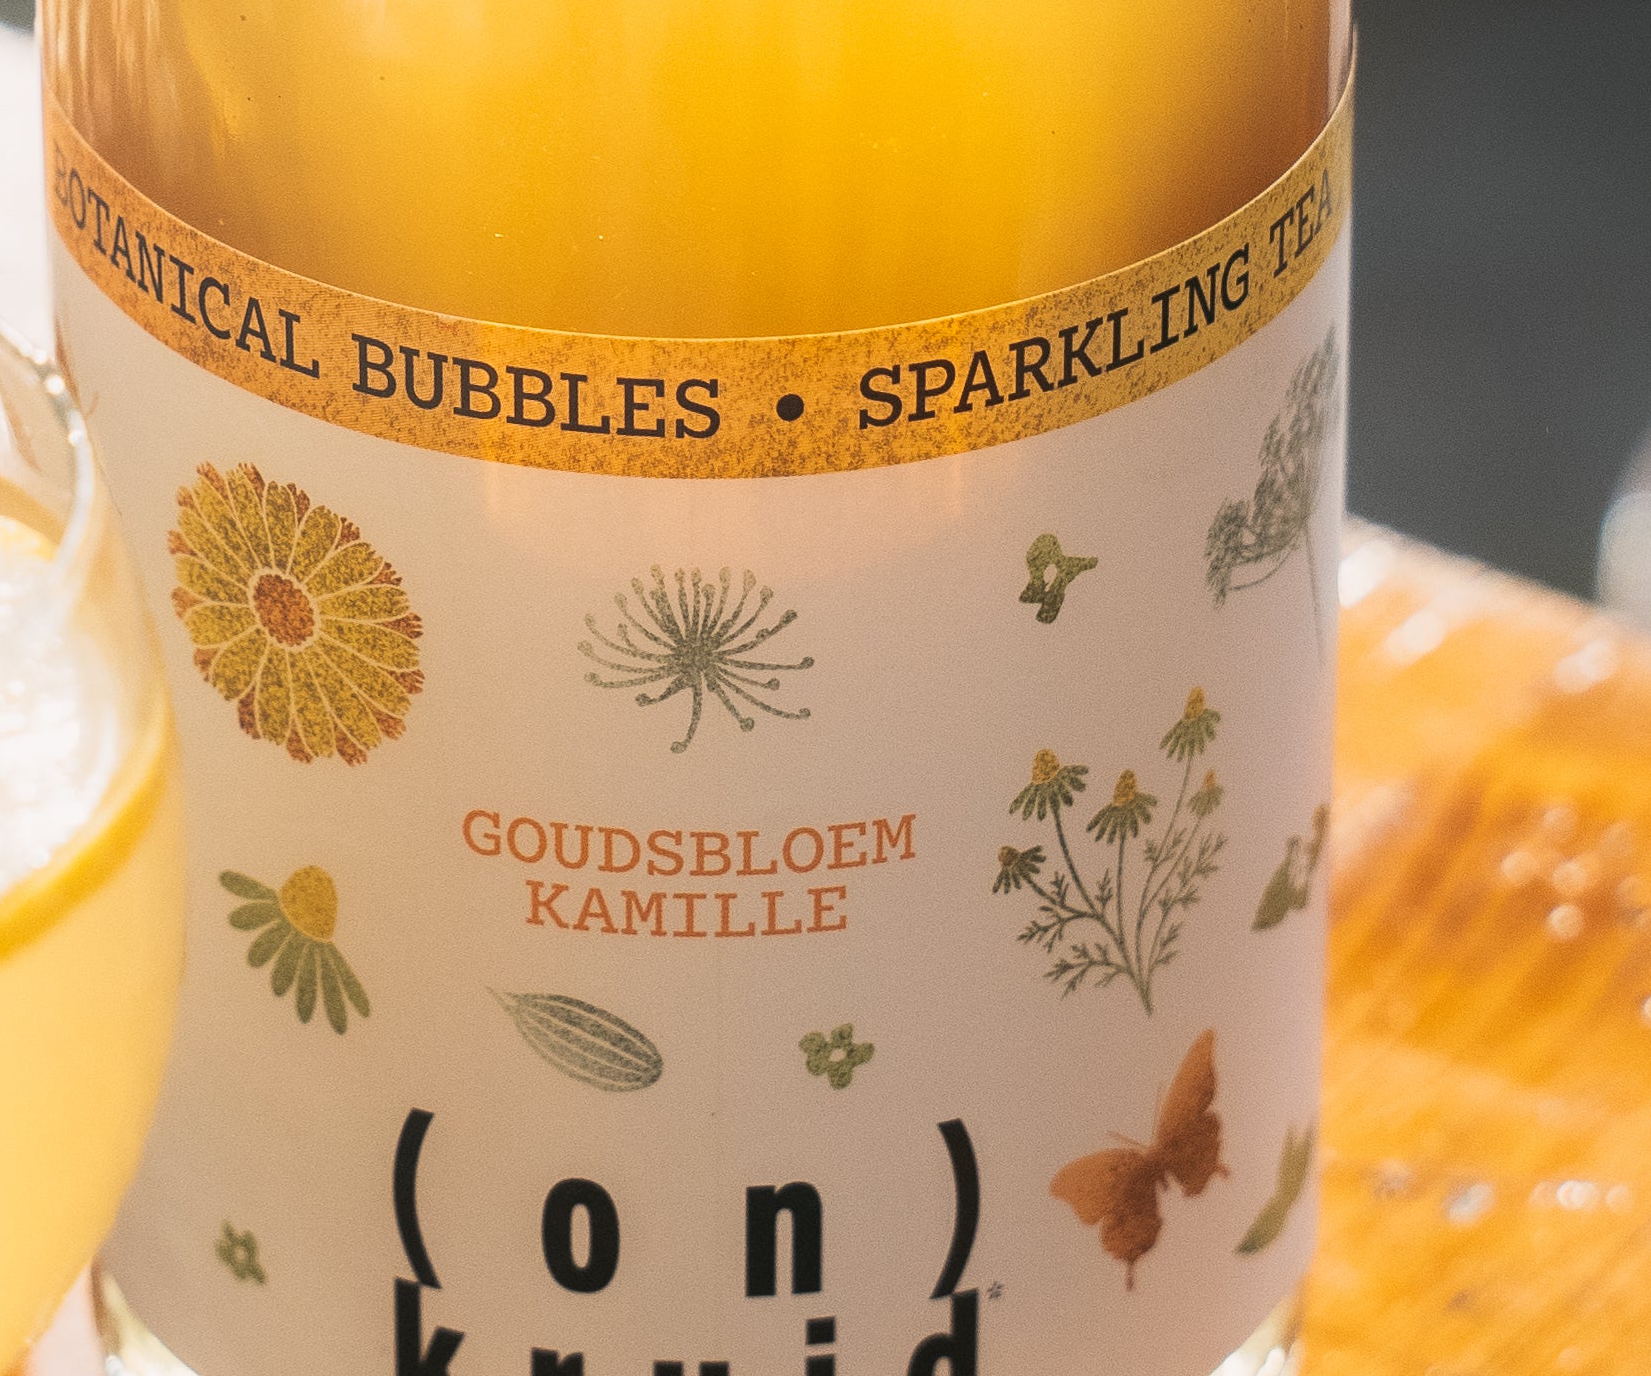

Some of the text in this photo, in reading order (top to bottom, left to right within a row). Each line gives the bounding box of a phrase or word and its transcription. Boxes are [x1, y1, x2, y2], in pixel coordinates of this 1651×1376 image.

[351, 333, 721, 440] BUBBLES
[858, 242, 1251, 431] SPARKLING
[1269, 168, 1333, 278] TEA
[461, 809, 917, 877] GOUDSBLOEM
[524, 880, 849, 938] KAMILLE
